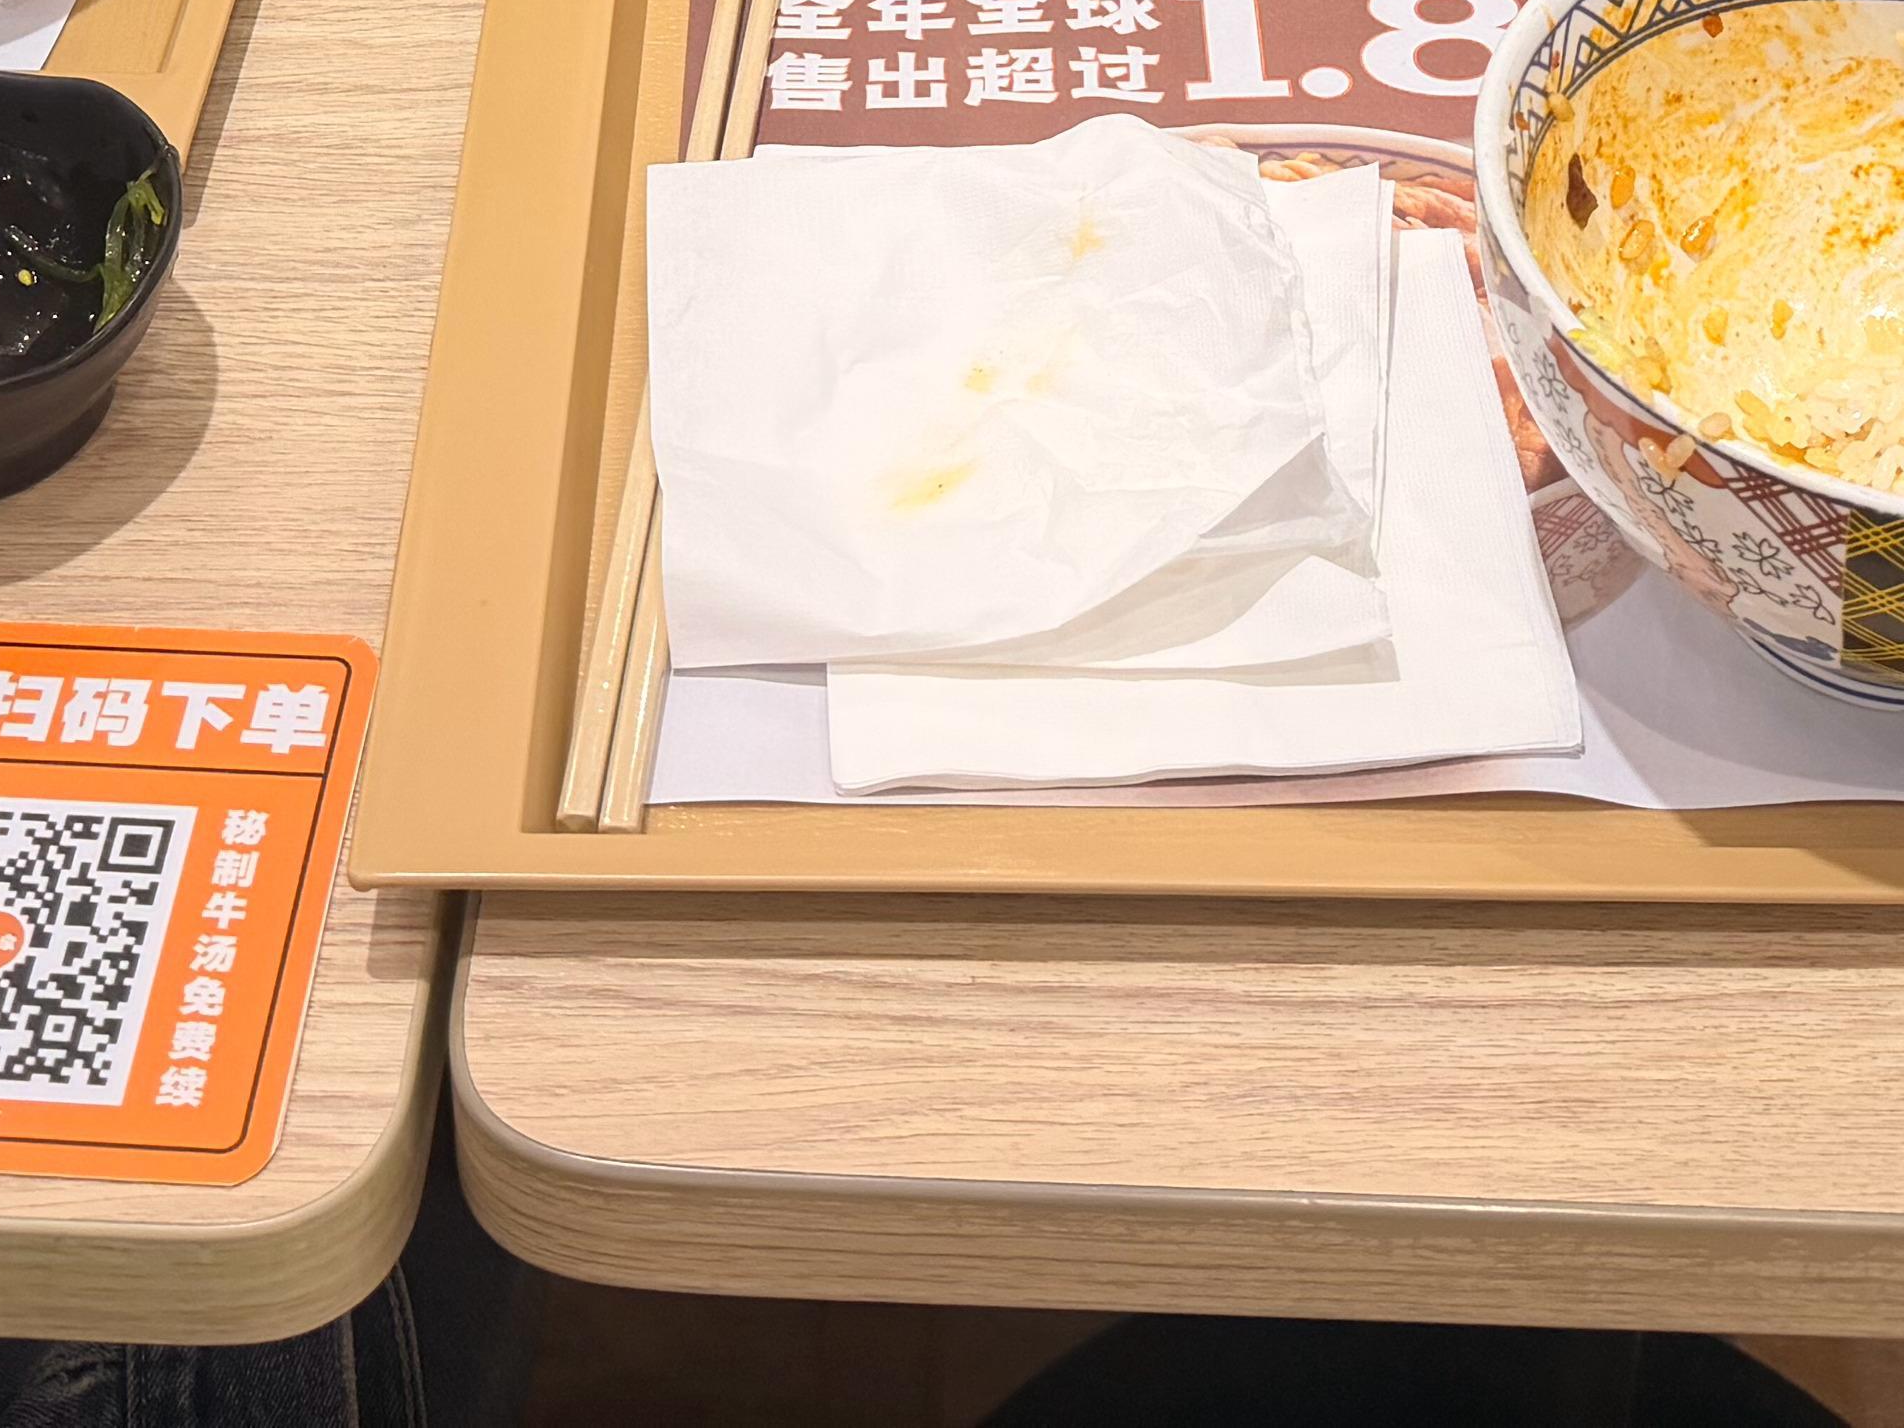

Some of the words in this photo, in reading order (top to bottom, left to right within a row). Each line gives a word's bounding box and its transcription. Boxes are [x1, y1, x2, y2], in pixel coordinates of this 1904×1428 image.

[767, 46, 1165, 112] 售出超过
[156, 808, 270, 1108] 秘制牛汤免费续
